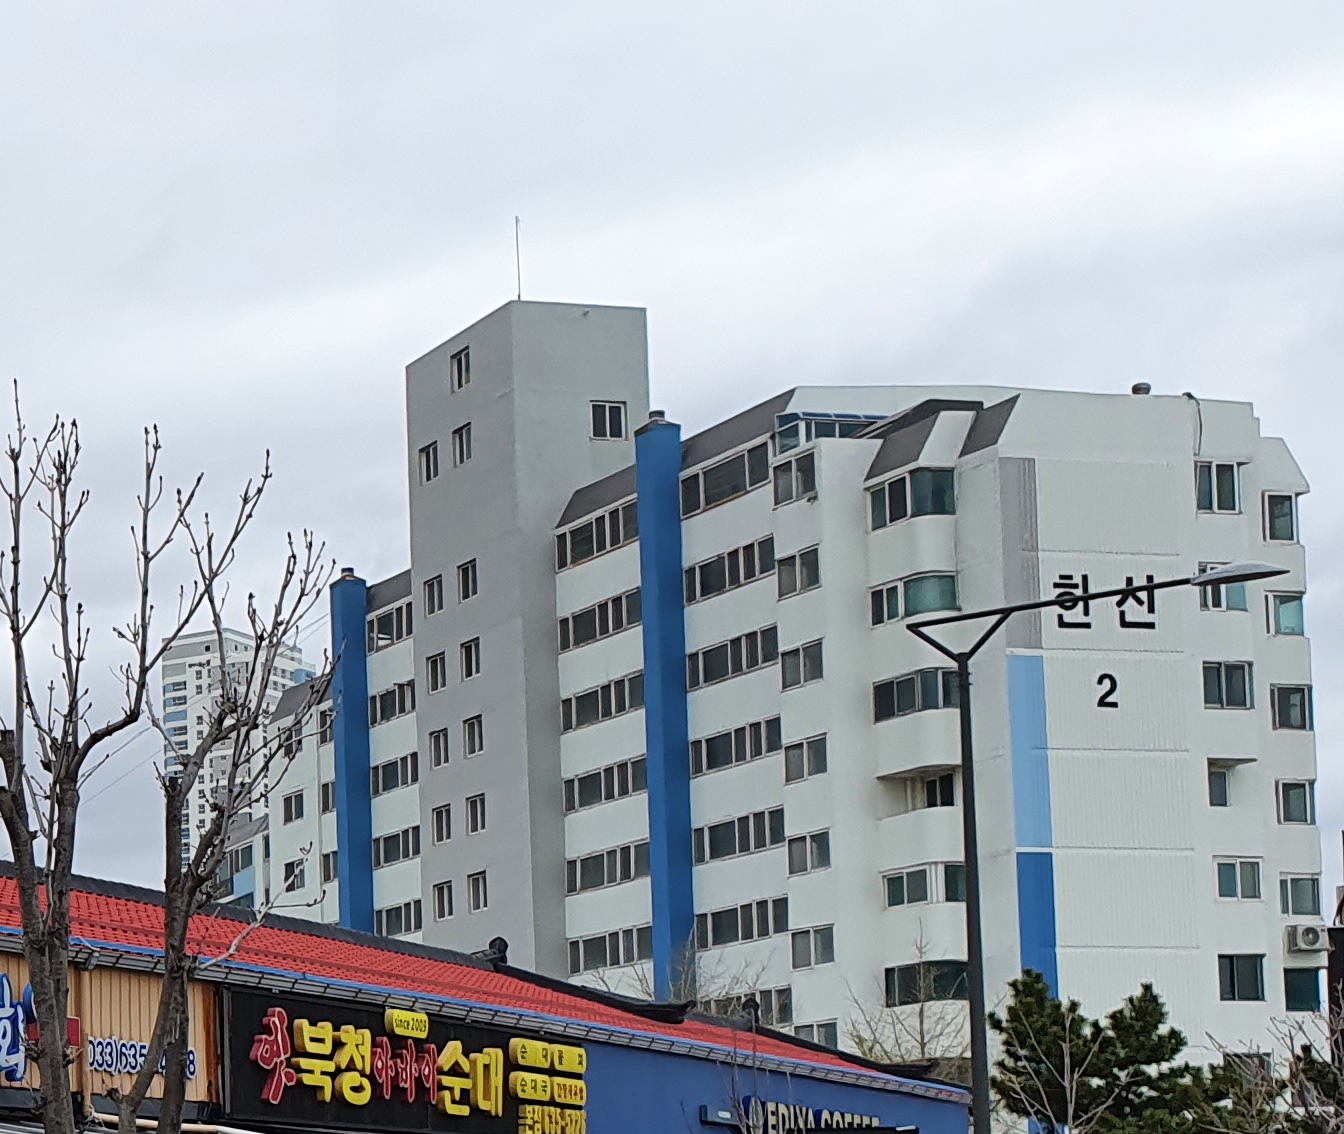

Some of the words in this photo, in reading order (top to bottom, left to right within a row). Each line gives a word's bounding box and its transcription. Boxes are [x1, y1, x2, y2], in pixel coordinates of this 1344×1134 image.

[1097, 673, 1119, 708] 2
[291, 1018, 372, 1106] 북청
[372, 1036, 438, 1105] 아바이
[436, 1040, 504, 1118] 순대
